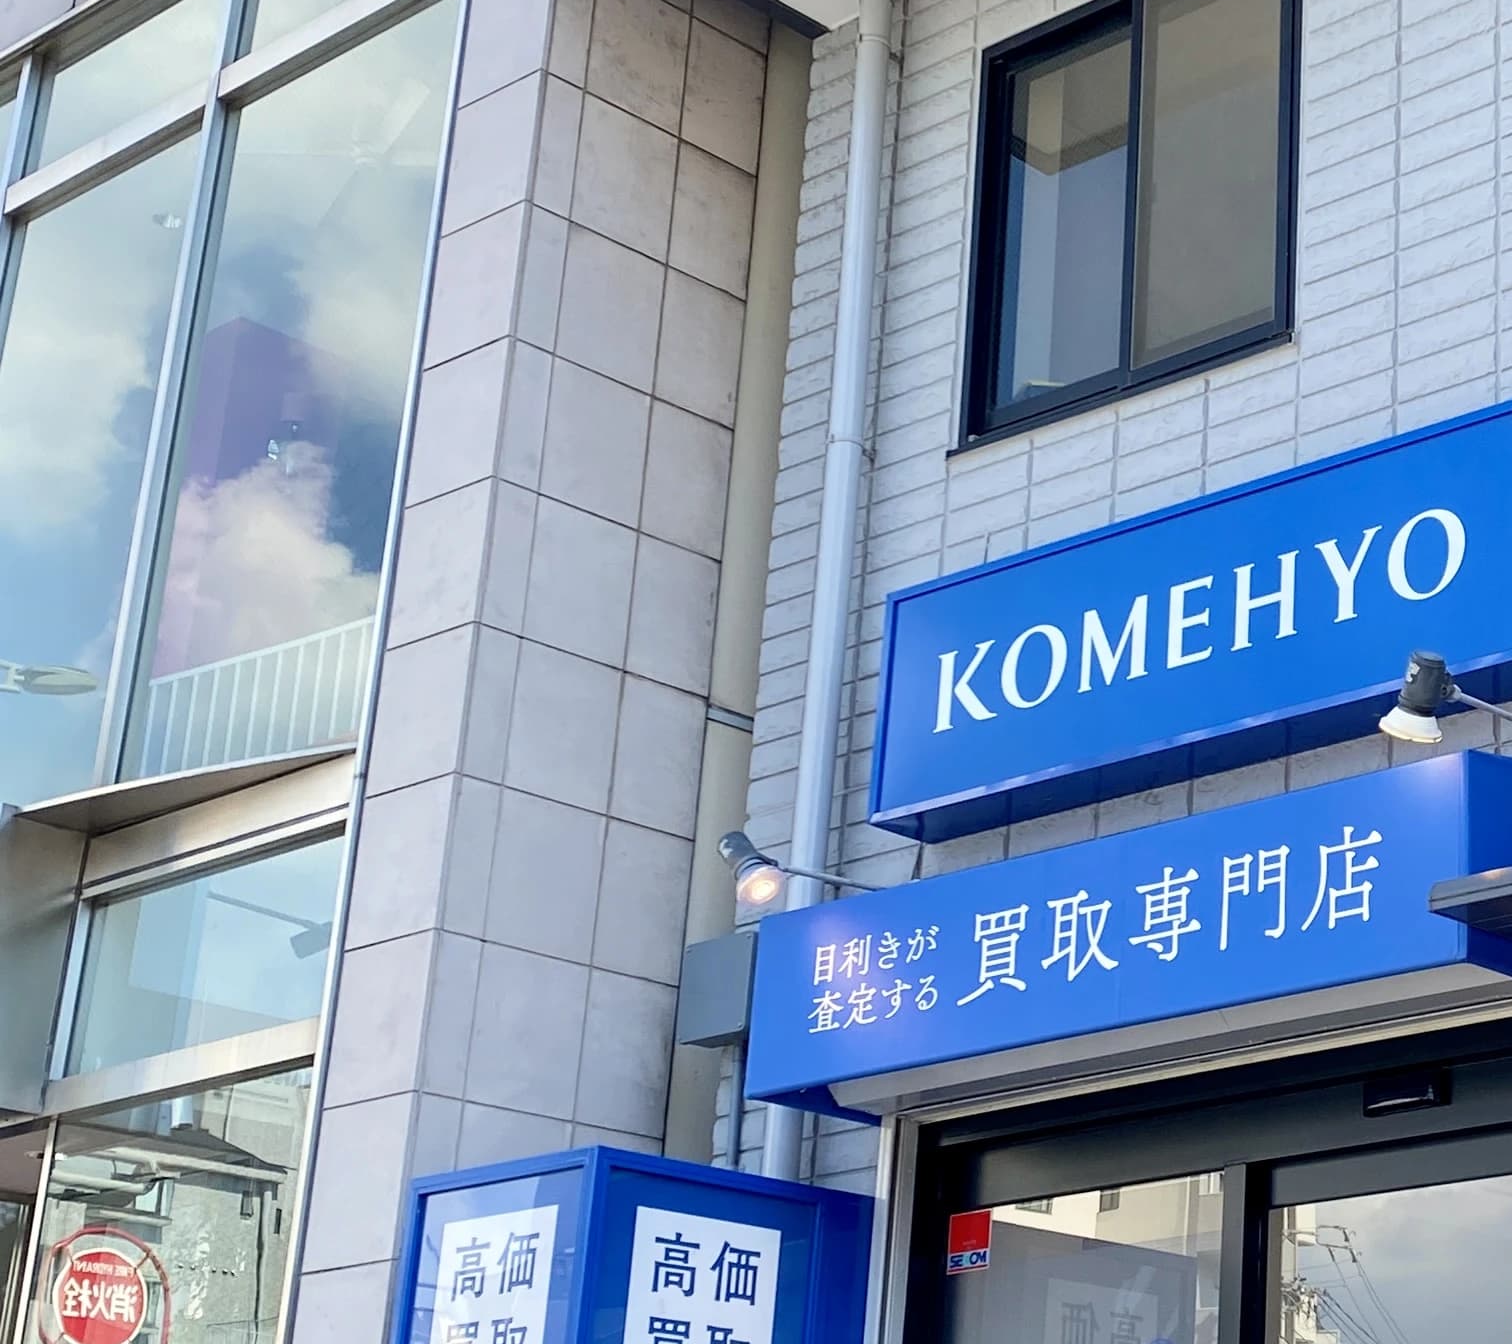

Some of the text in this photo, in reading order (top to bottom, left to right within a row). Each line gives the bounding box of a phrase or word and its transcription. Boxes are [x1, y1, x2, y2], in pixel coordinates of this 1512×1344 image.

[933, 507, 1467, 734] KOMEHYO
[957, 826, 1385, 1006] 買取専門店
[811, 924, 939, 988] 目利きが
[807, 974, 940, 1035] 査定する
[449, 1230, 541, 1304] 高価
[650, 1232, 763, 1307] 高価
